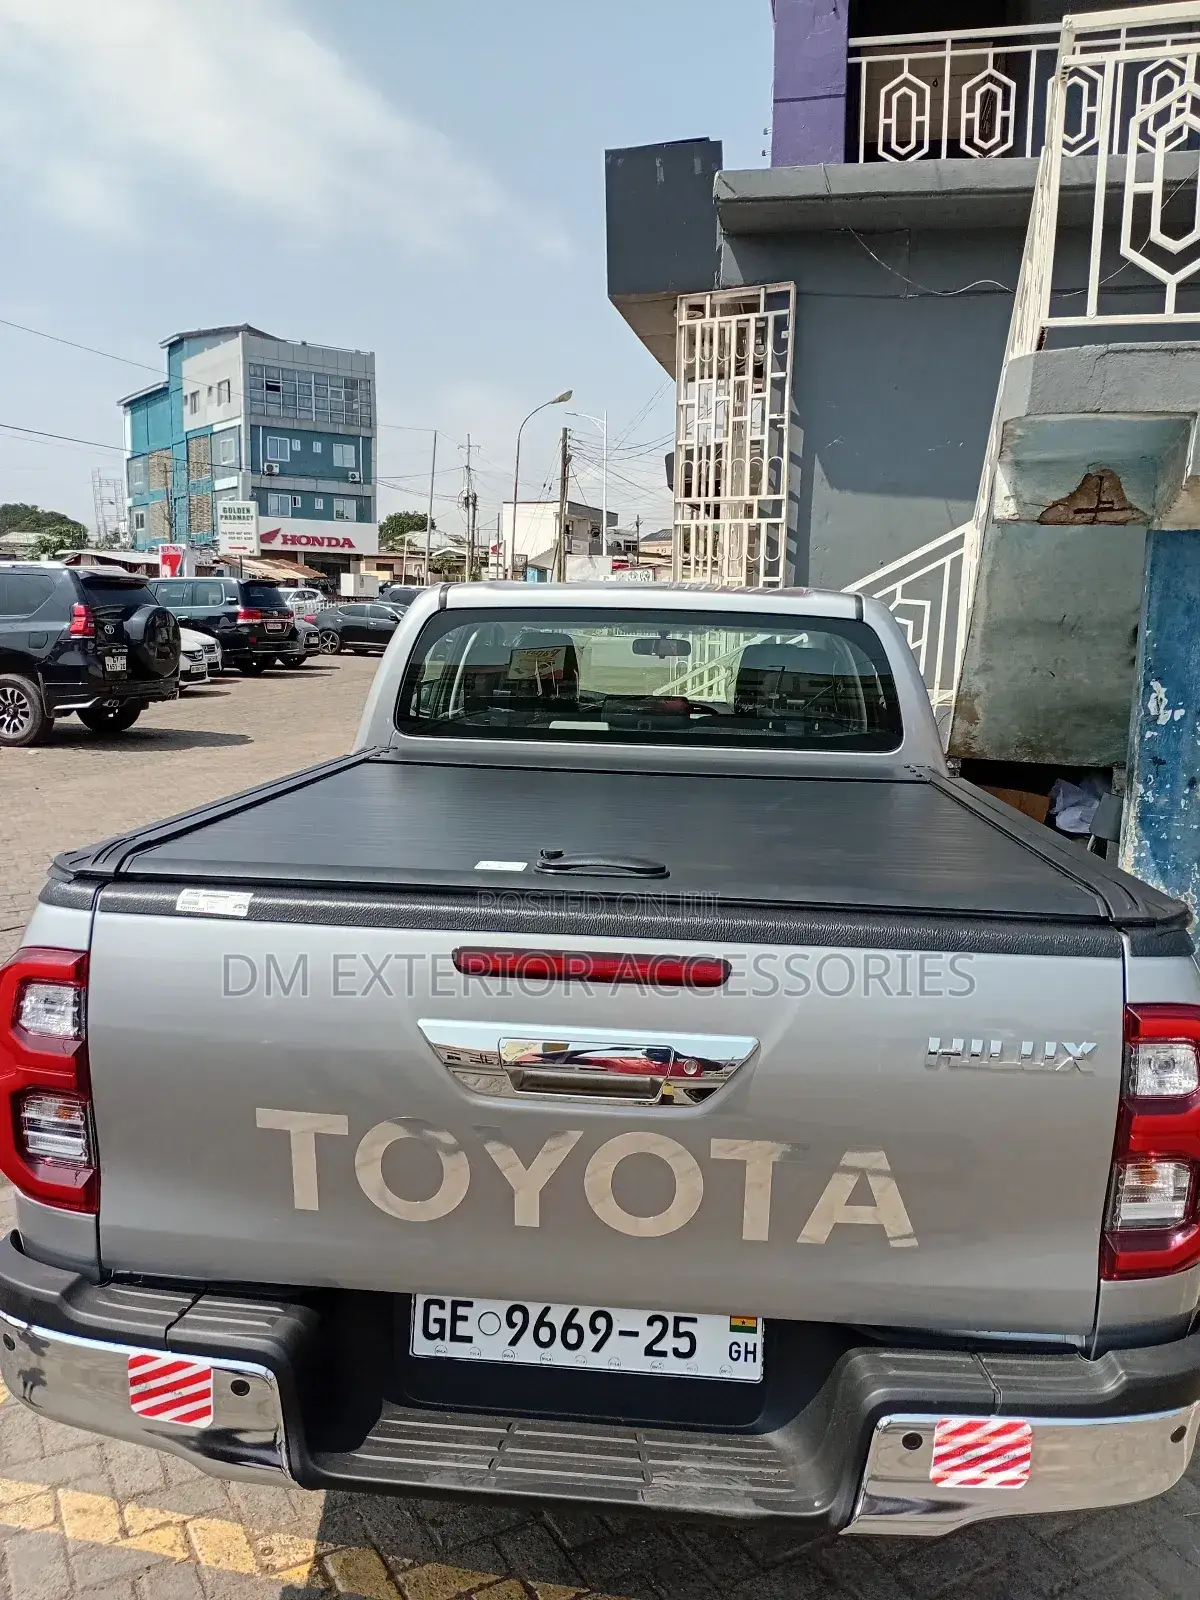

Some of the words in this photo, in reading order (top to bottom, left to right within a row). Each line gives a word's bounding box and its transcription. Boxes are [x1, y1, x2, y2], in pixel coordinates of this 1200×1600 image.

[281, 534, 356, 548] HONDA
[925, 1037, 1097, 1072] HILUX
[255, 1107, 919, 1249] TOYOTA
[421, 1298, 475, 1344] GE
[505, 1303, 699, 1360] 9669-25
[728, 1341, 758, 1364] GH
